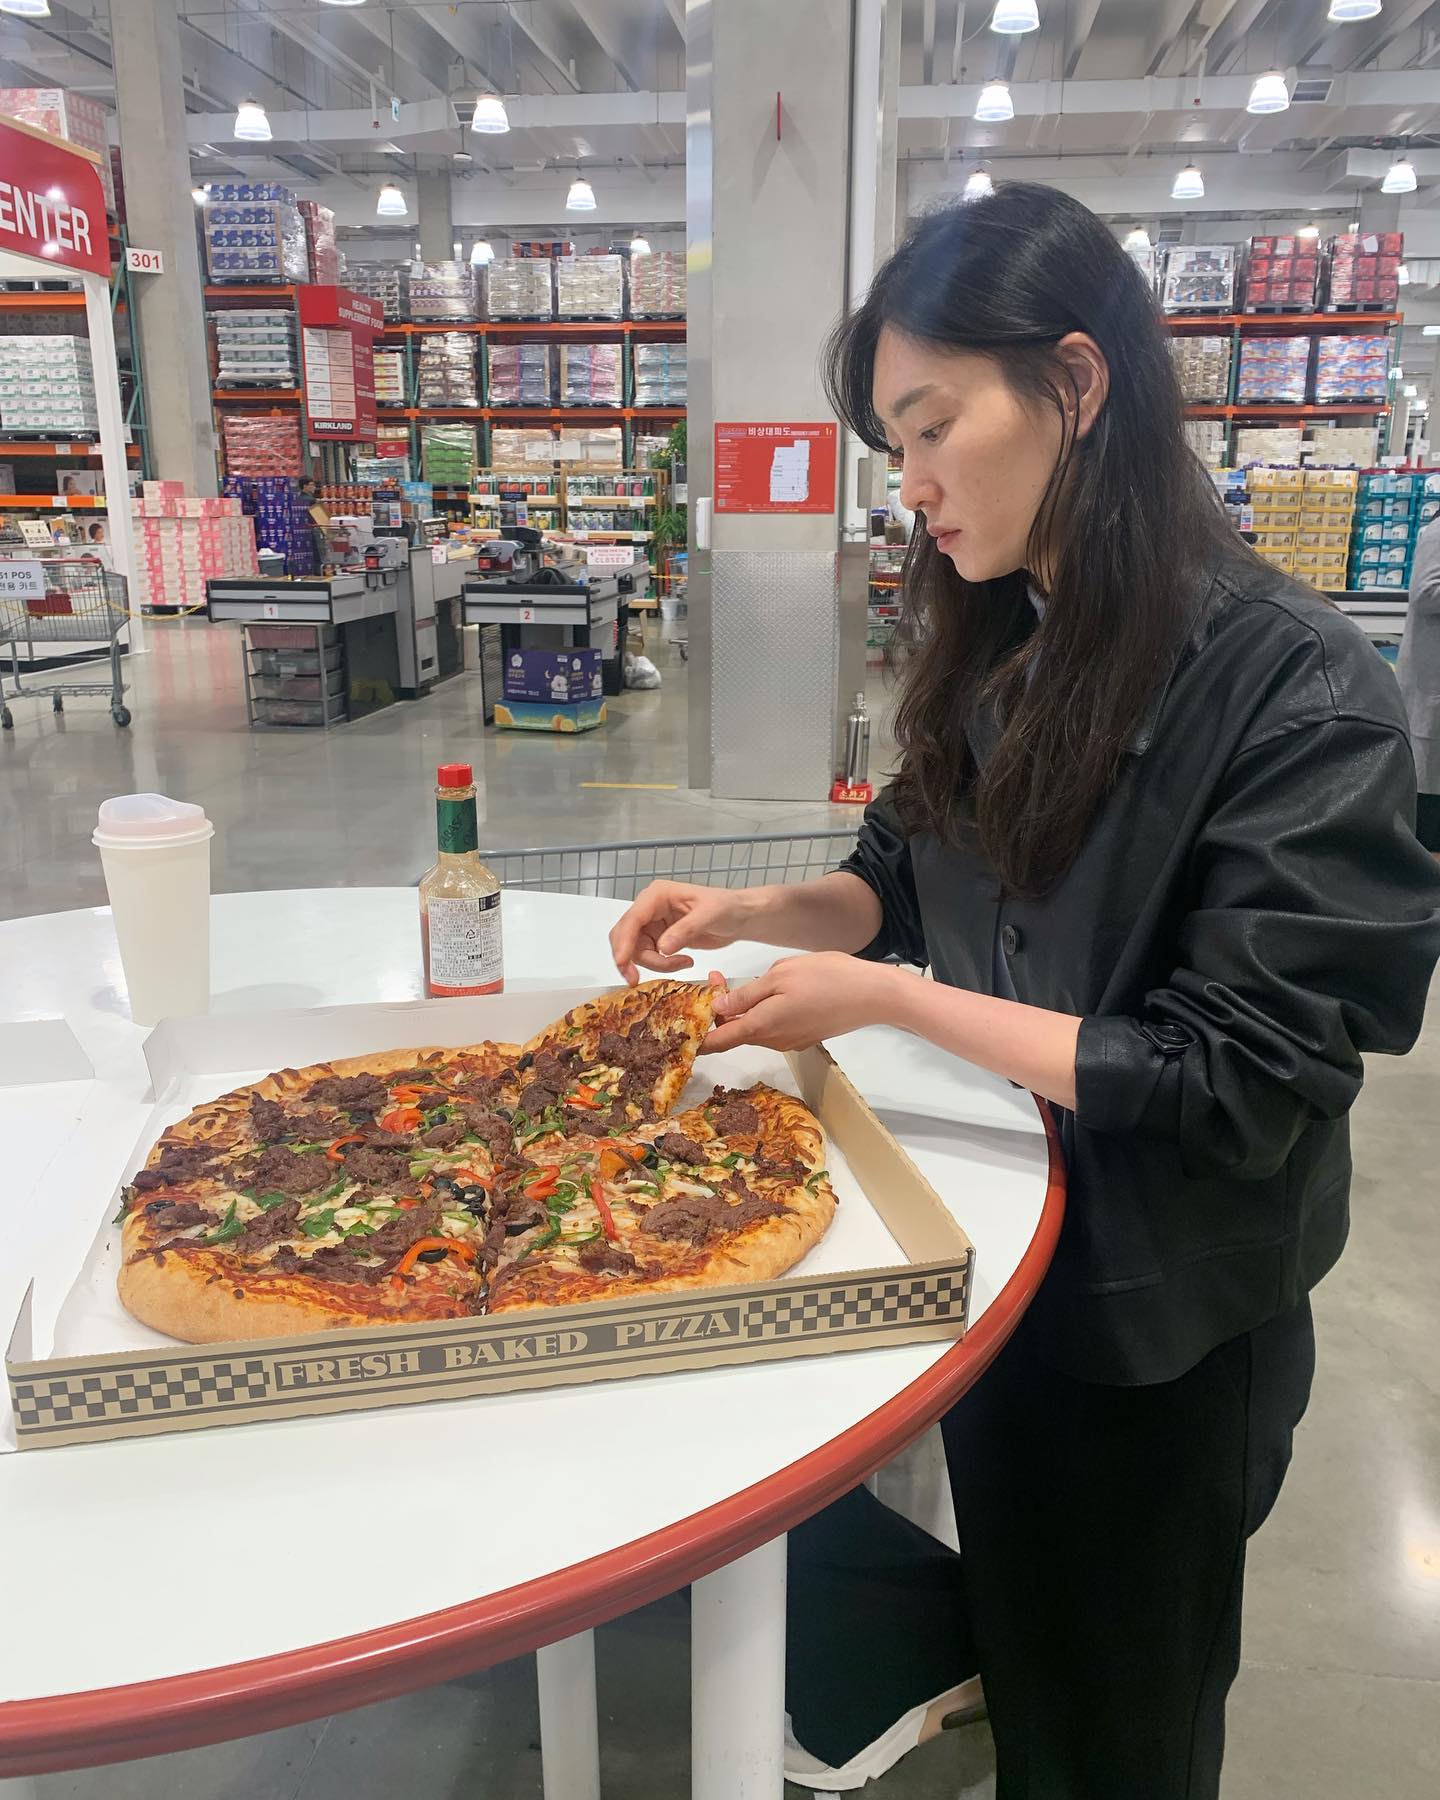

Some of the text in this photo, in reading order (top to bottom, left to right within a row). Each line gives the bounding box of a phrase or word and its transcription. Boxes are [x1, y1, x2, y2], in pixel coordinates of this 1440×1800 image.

[131, 253, 159, 269] 301
[352, 299, 371, 314] HEALTH
[338, 306, 384, 330] SUPPLEMENT FOOD
[314, 421, 353, 430] KIRKLAND
[748, 427, 791, 437] 비상대피도
[11, 571, 32, 579] POS
[19, 581, 37, 590] 카트
[267, 606, 273, 616] 1
[523, 610, 531, 620] 2
[278, 1312, 732, 1387] FRESH BAKED PIZZA
